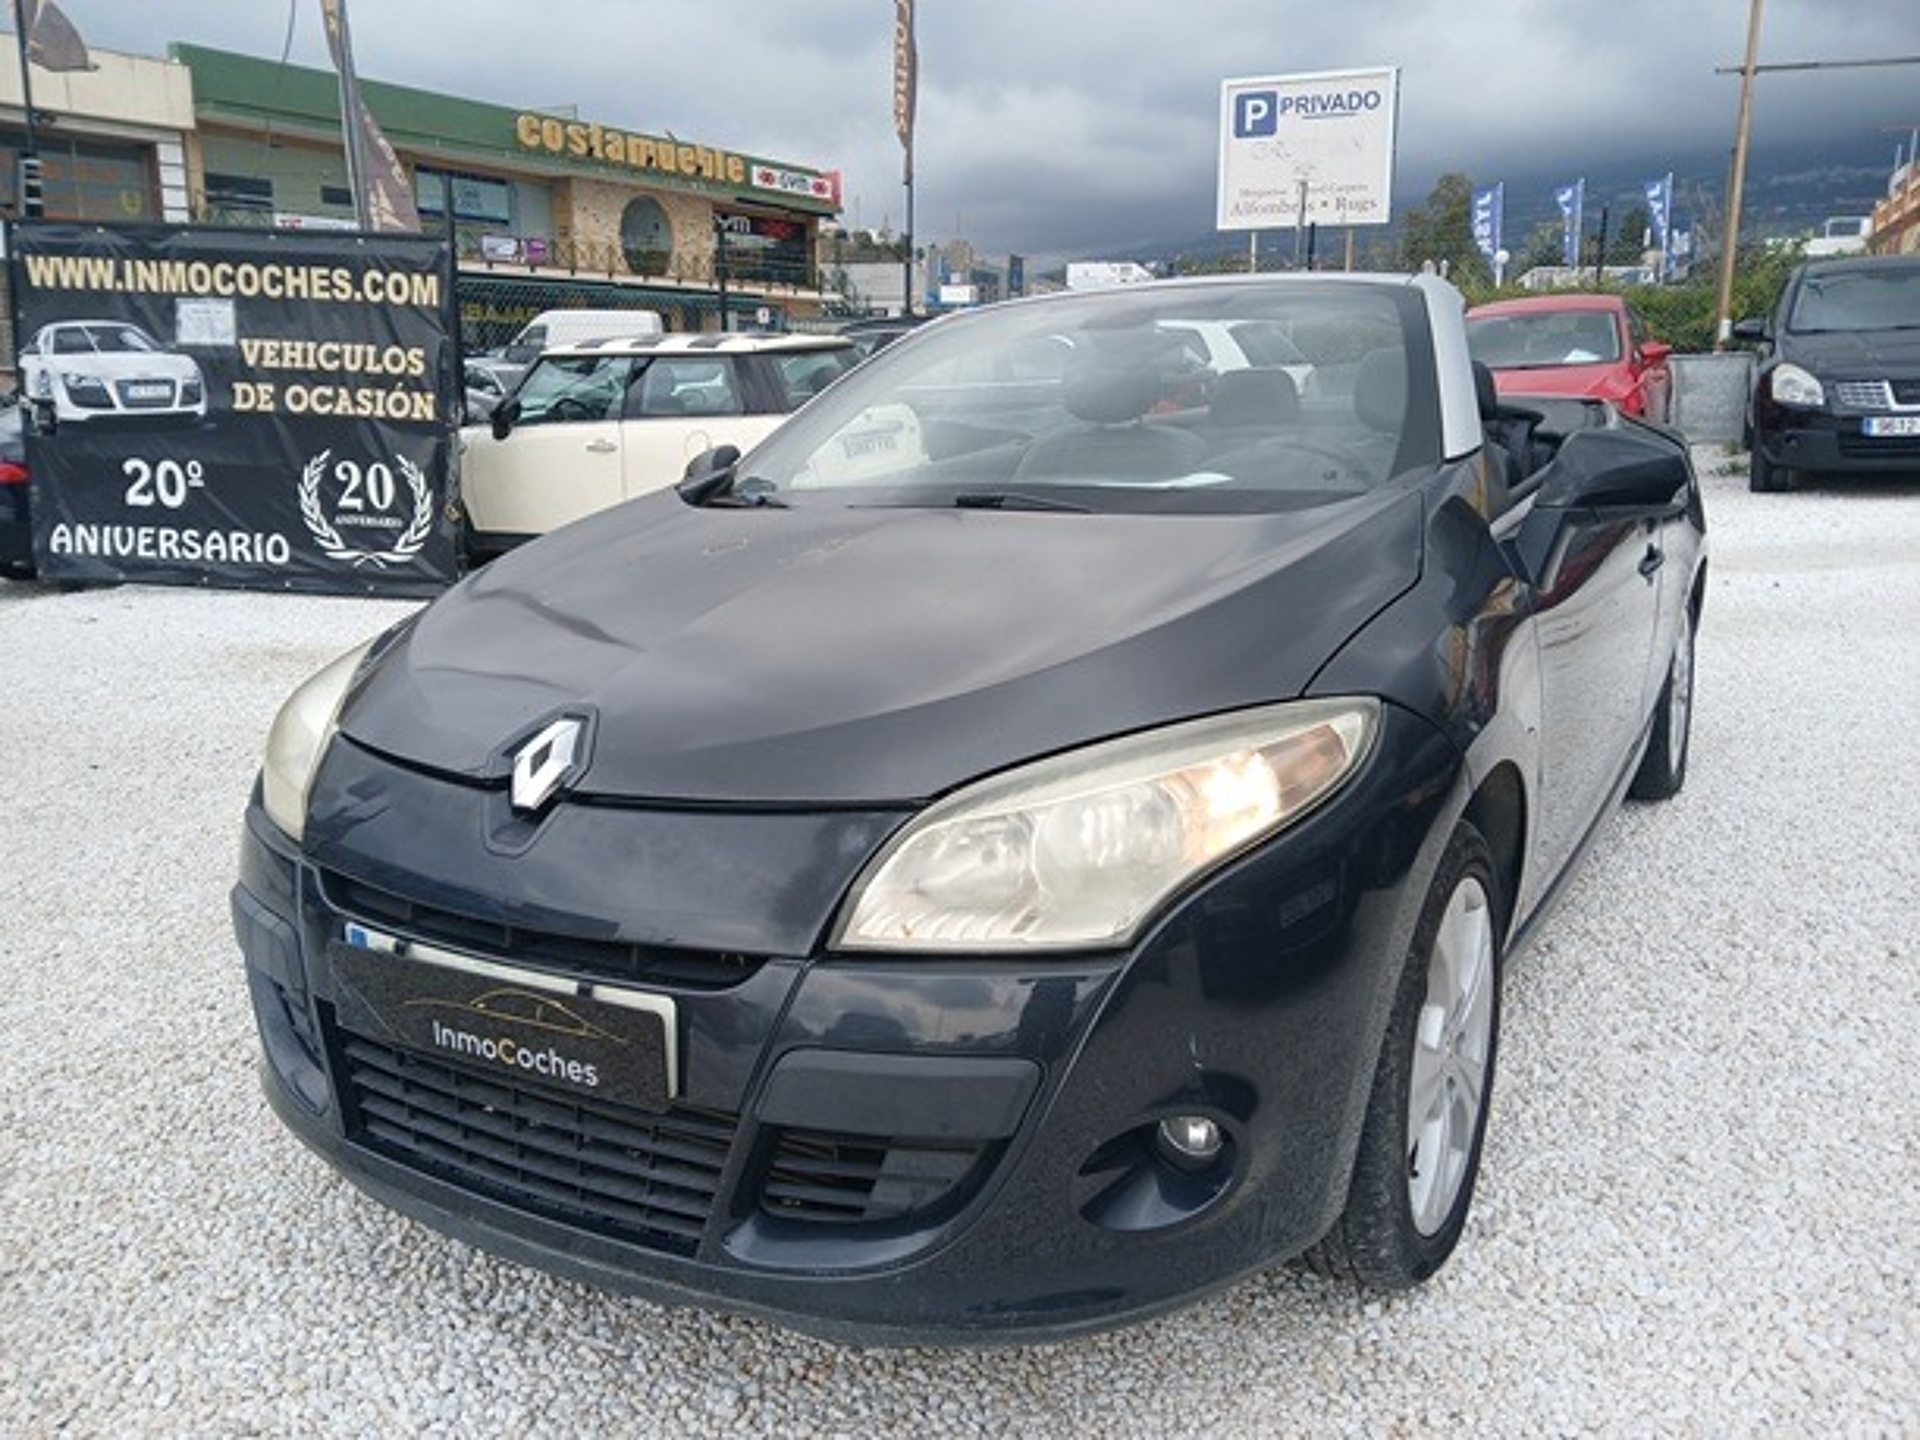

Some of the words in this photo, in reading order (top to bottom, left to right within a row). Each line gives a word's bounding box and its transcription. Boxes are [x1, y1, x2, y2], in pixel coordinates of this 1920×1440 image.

[1245, 99, 1268, 132] P
[1280, 90, 1381, 114] PRIVADO
[516, 113, 745, 184] costamueble
[1230, 198, 1315, 217] Alfombrs
[25, 254, 439, 306] WWW.INMOCOCHES.COM
[240, 338, 425, 376] VEHICULOS
[232, 382, 274, 413] DE
[284, 382, 435, 421] OCASIÓN
[334, 459, 396, 511] 20
[334, 513, 403, 528] ANIVERSARIO
[50, 523, 290, 564] ANIVERSARIO
[432, 1019, 599, 1087] InmoCoches
